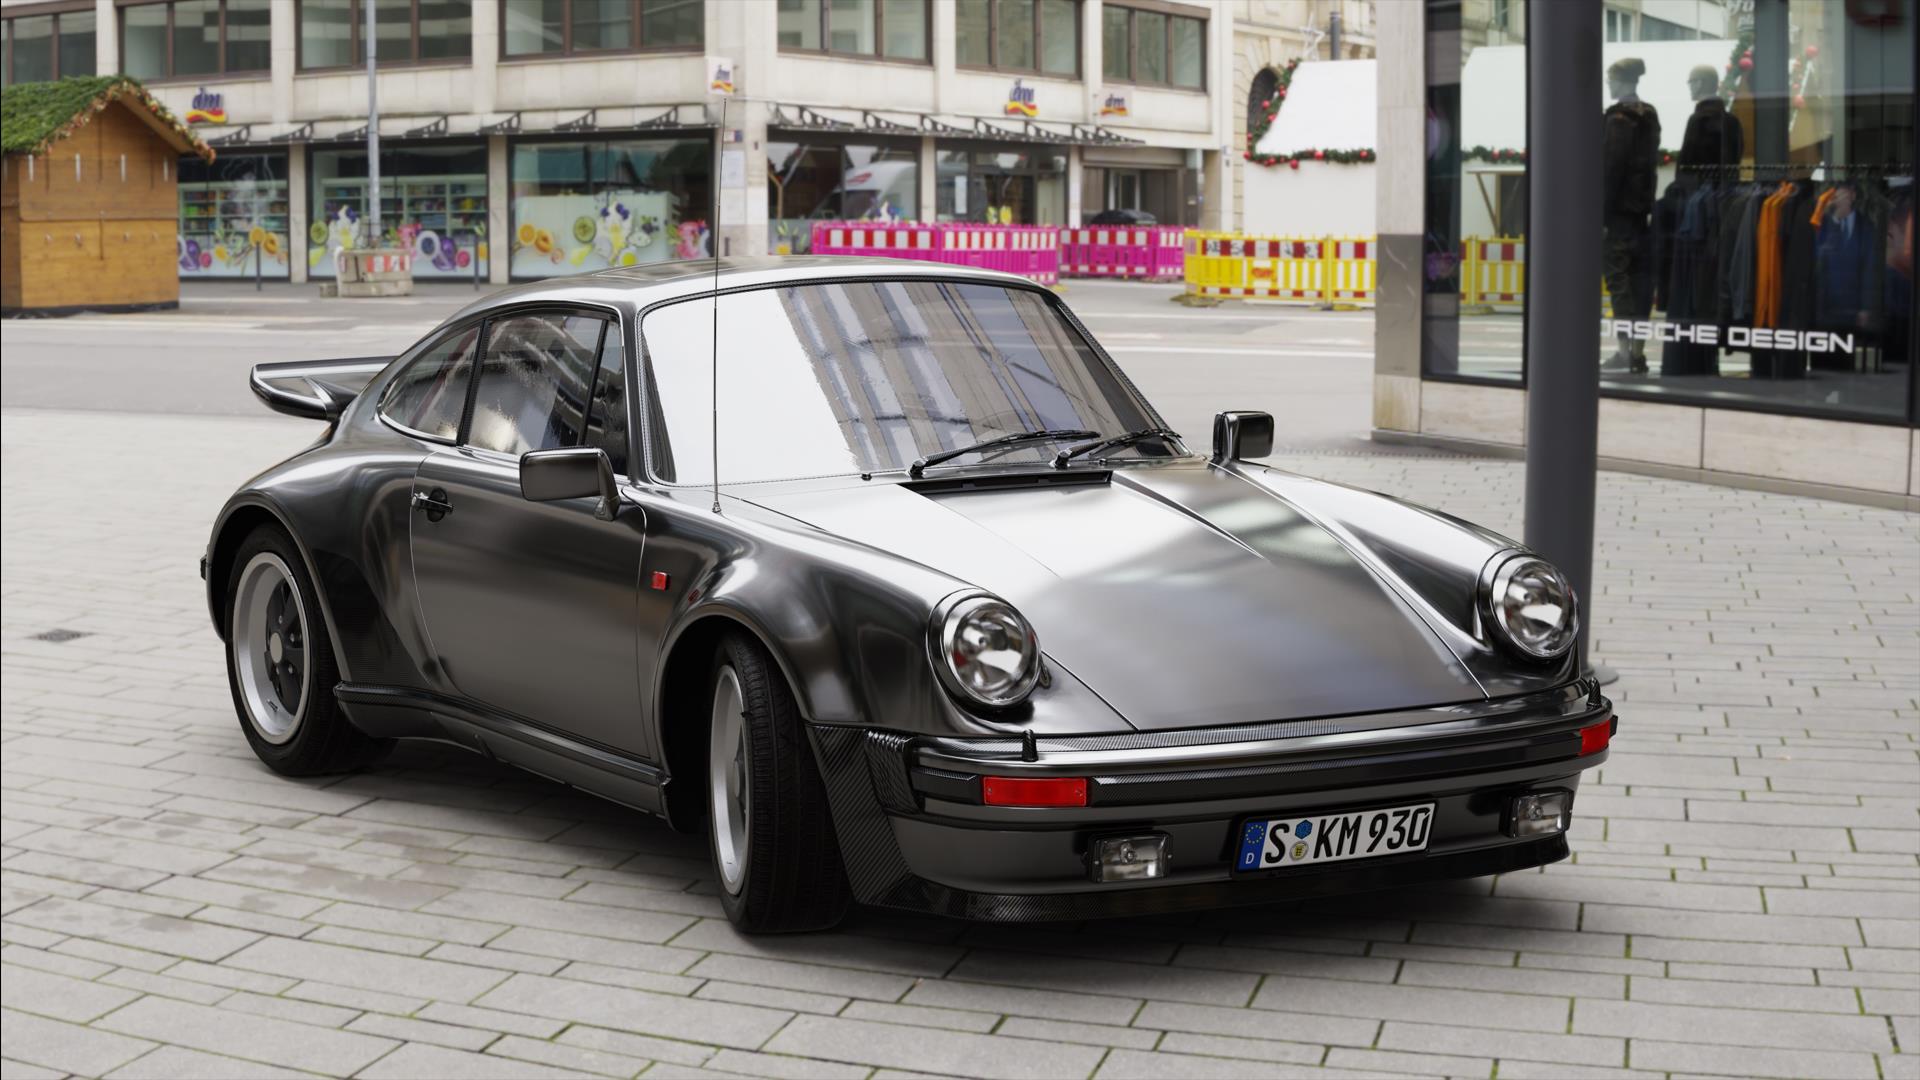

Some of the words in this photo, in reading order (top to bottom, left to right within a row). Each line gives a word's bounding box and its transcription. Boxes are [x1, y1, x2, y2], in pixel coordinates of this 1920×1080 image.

[192, 87, 222, 109] dm
[1009, 79, 1034, 102] dm
[1600, 318, 1718, 345] ORSCHE
[1727, 325, 1854, 354] DESIGN
[1264, 822, 1290, 864] S
[1313, 815, 1363, 859] KM
[1366, 806, 1431, 853] 930
[1245, 852, 1255, 865] D
